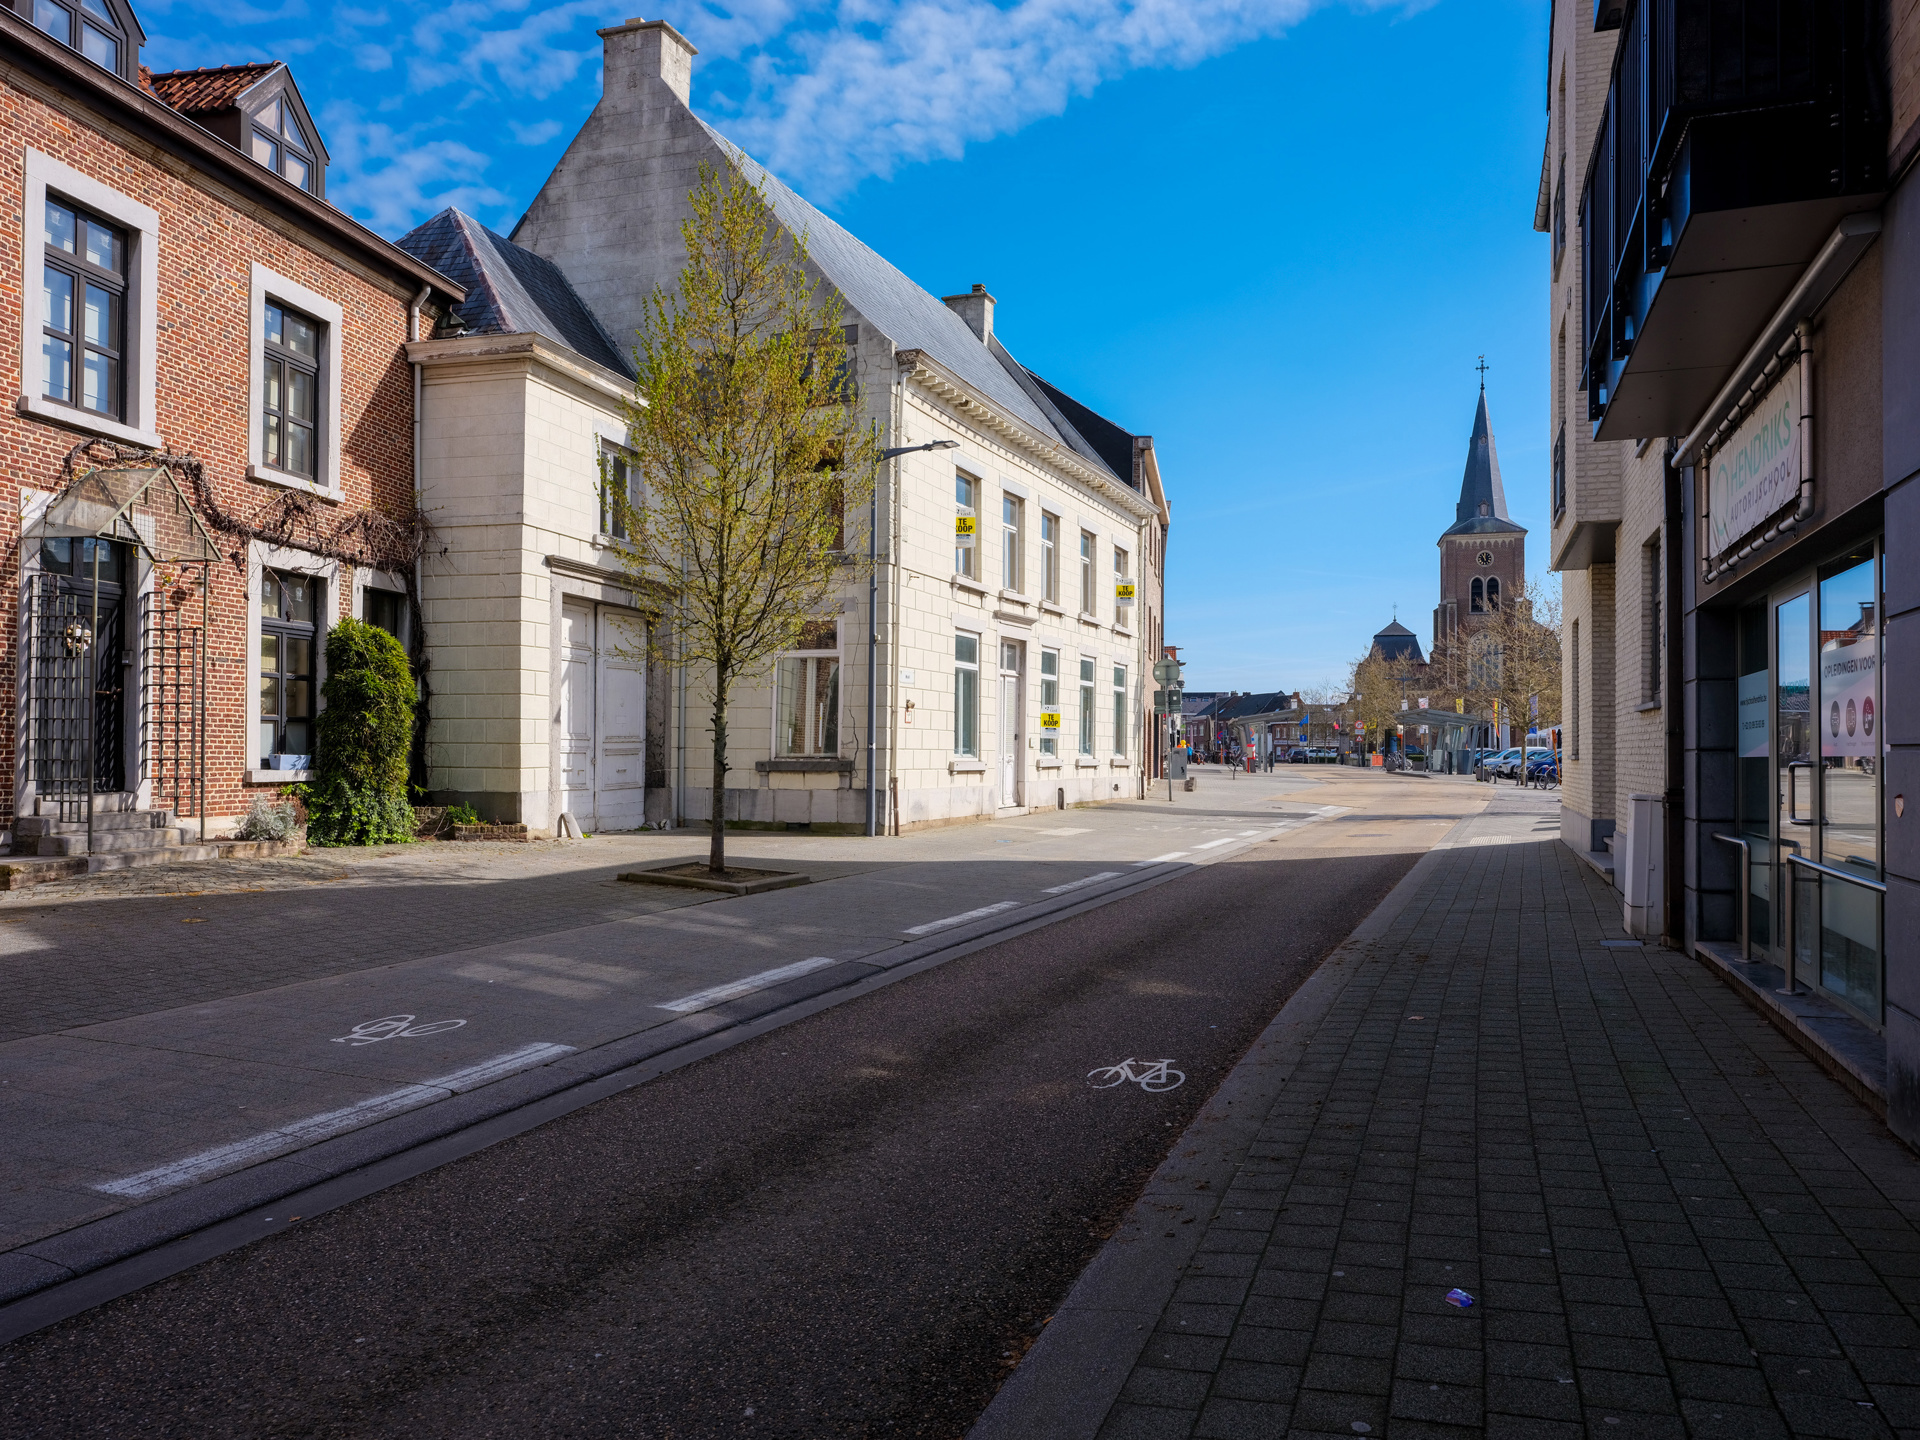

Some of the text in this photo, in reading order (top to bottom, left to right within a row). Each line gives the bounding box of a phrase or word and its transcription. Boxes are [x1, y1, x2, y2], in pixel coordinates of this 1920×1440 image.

[1731, 401, 1791, 496] HENDRIKS
[1730, 457, 1790, 524] AUTORIJSCHOOL
[1824, 659, 1858, 678] OPLEIDINGEN
